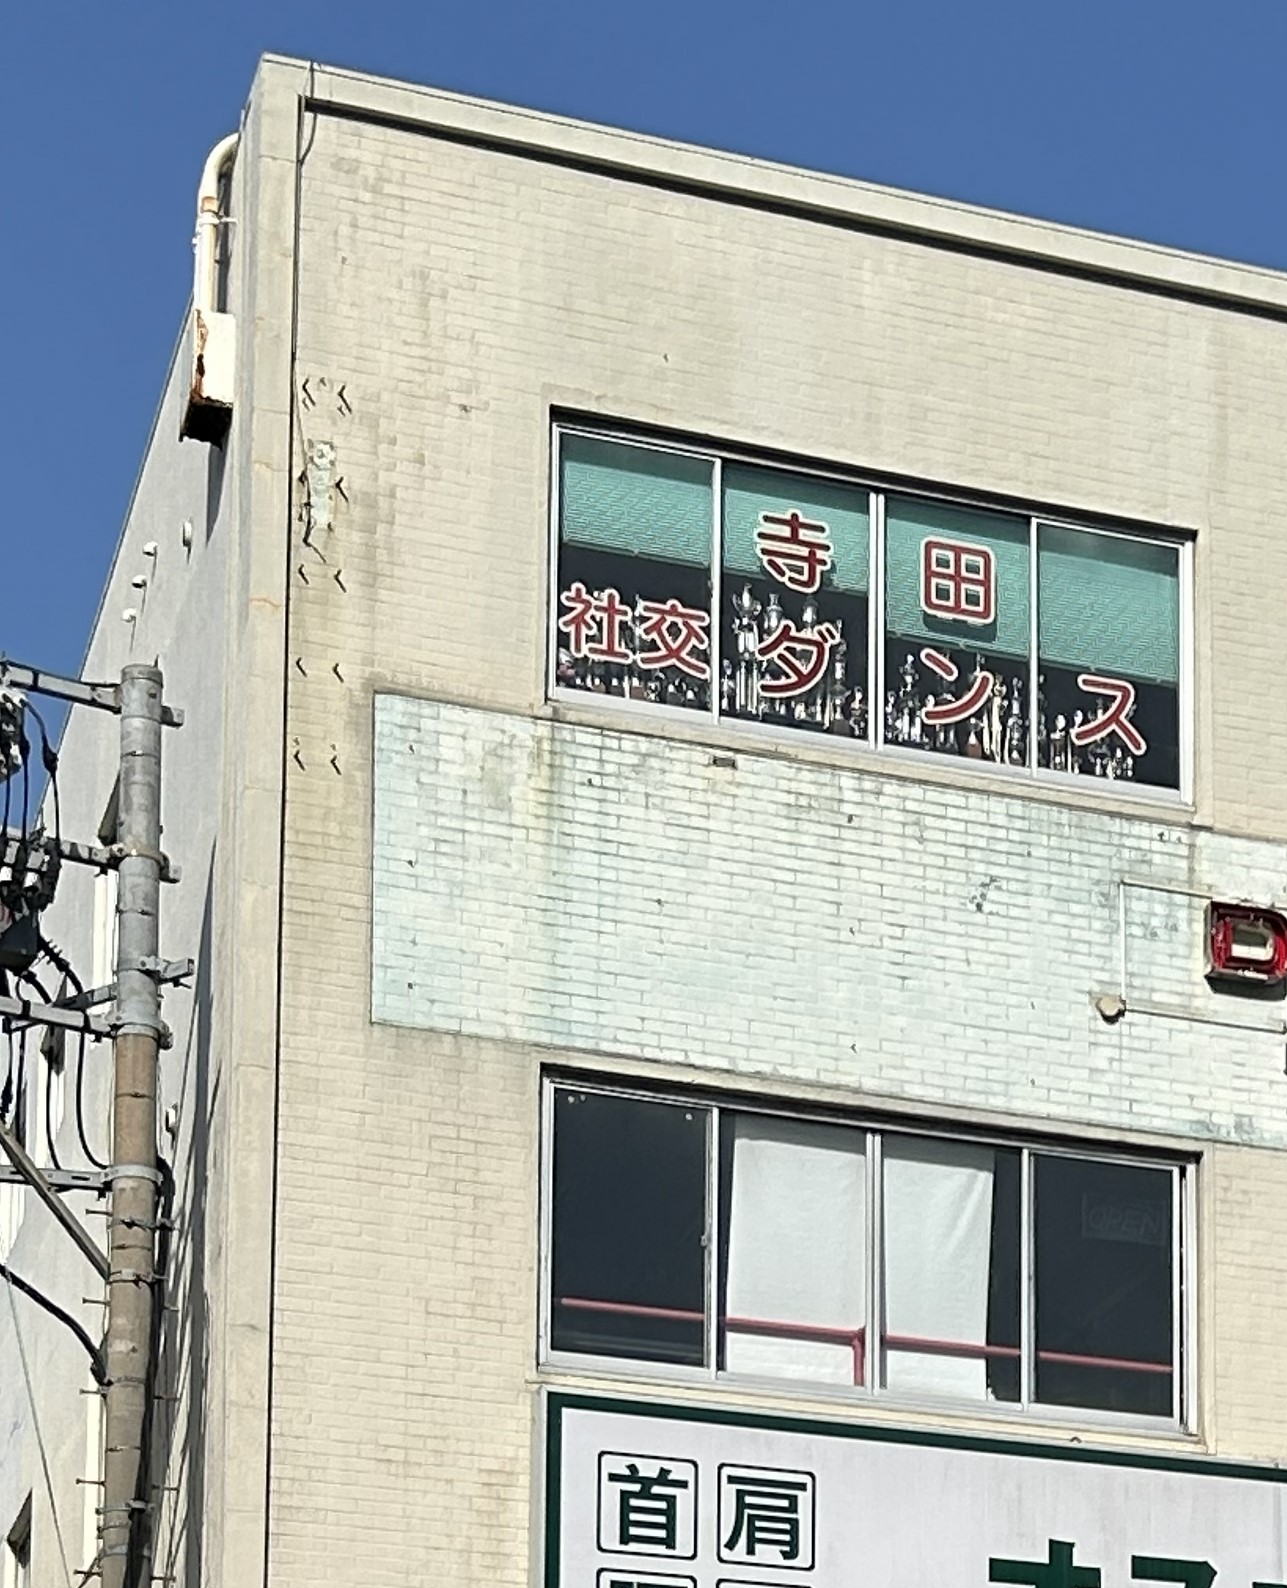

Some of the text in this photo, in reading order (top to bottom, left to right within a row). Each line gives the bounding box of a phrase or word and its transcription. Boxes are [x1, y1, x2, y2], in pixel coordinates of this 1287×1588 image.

[558, 582, 1147, 756] 社交ダンス
[607, 1464, 808, 1561] 首 肩
